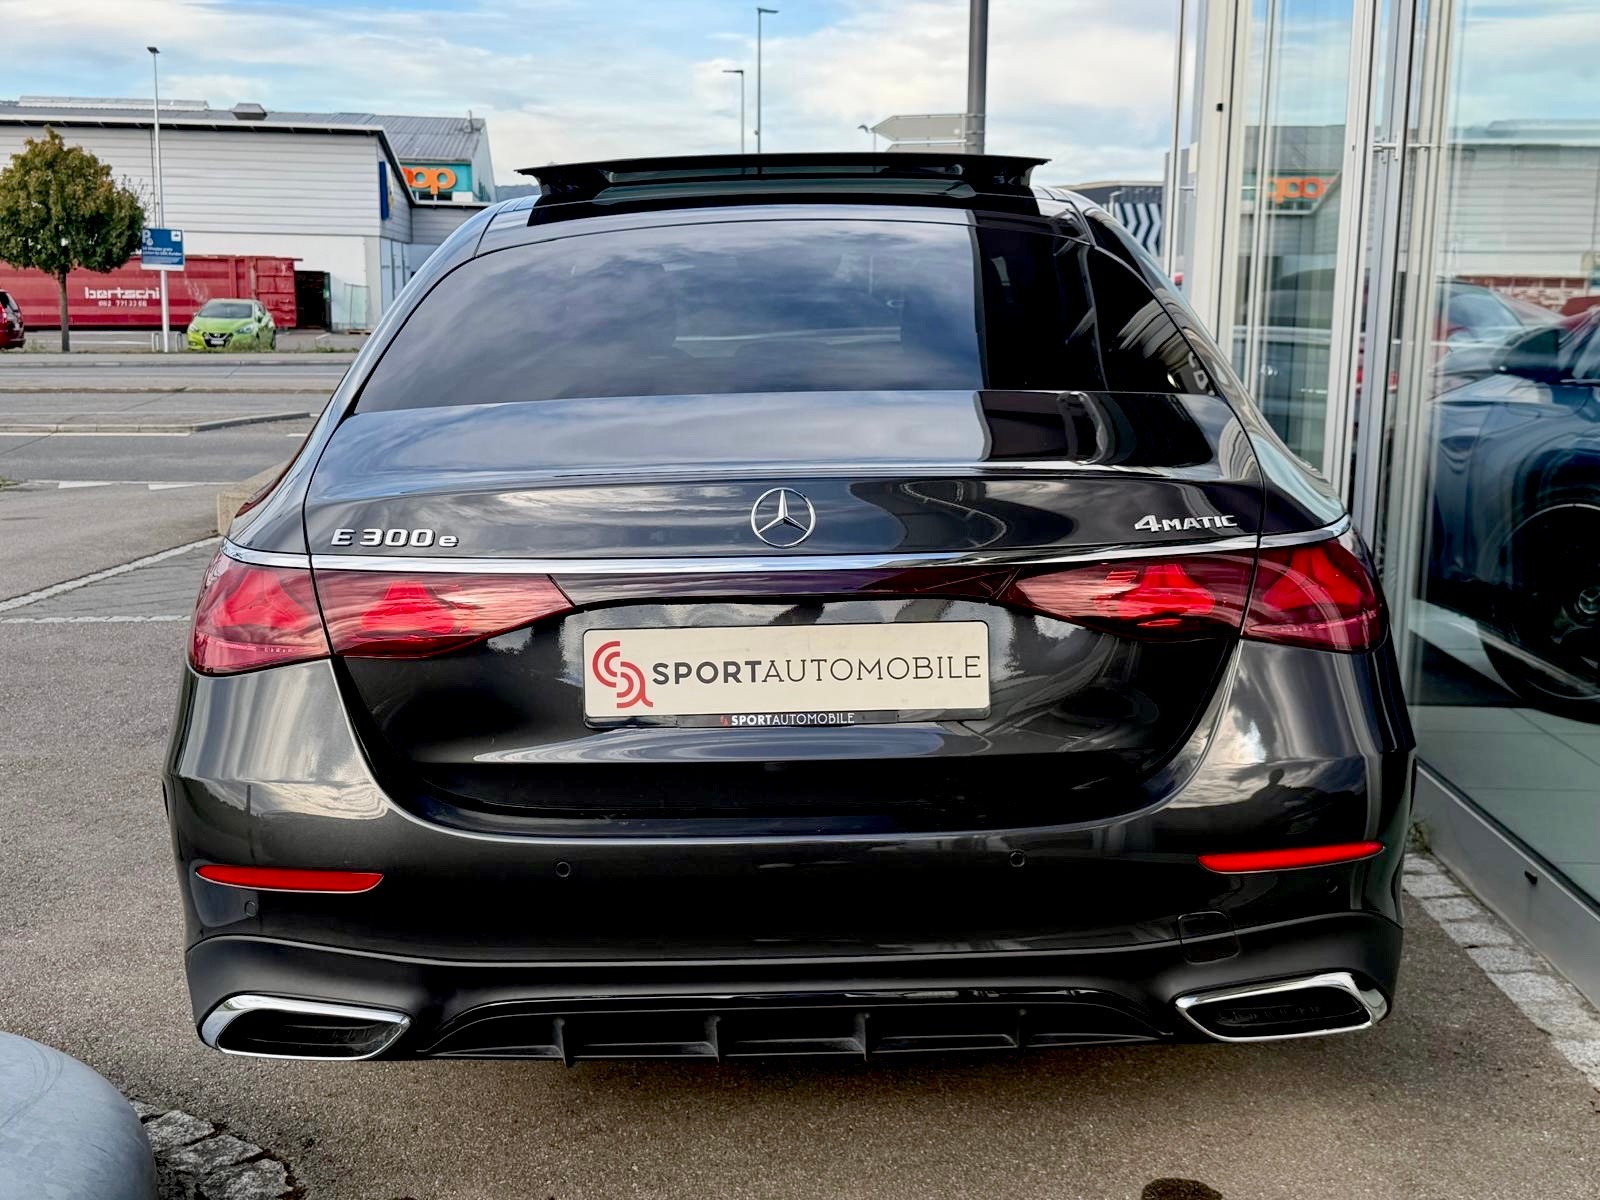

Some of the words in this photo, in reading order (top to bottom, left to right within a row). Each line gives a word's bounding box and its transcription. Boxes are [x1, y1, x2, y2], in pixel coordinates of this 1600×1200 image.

[84, 287, 160, 299] bertschi
[1134, 514, 1238, 533] 4MATIC
[331, 528, 356, 547] E
[652, 655, 982, 686] SPORTAUTOMOBILE
[732, 712, 856, 727] SPORTAUTOMOBILE
